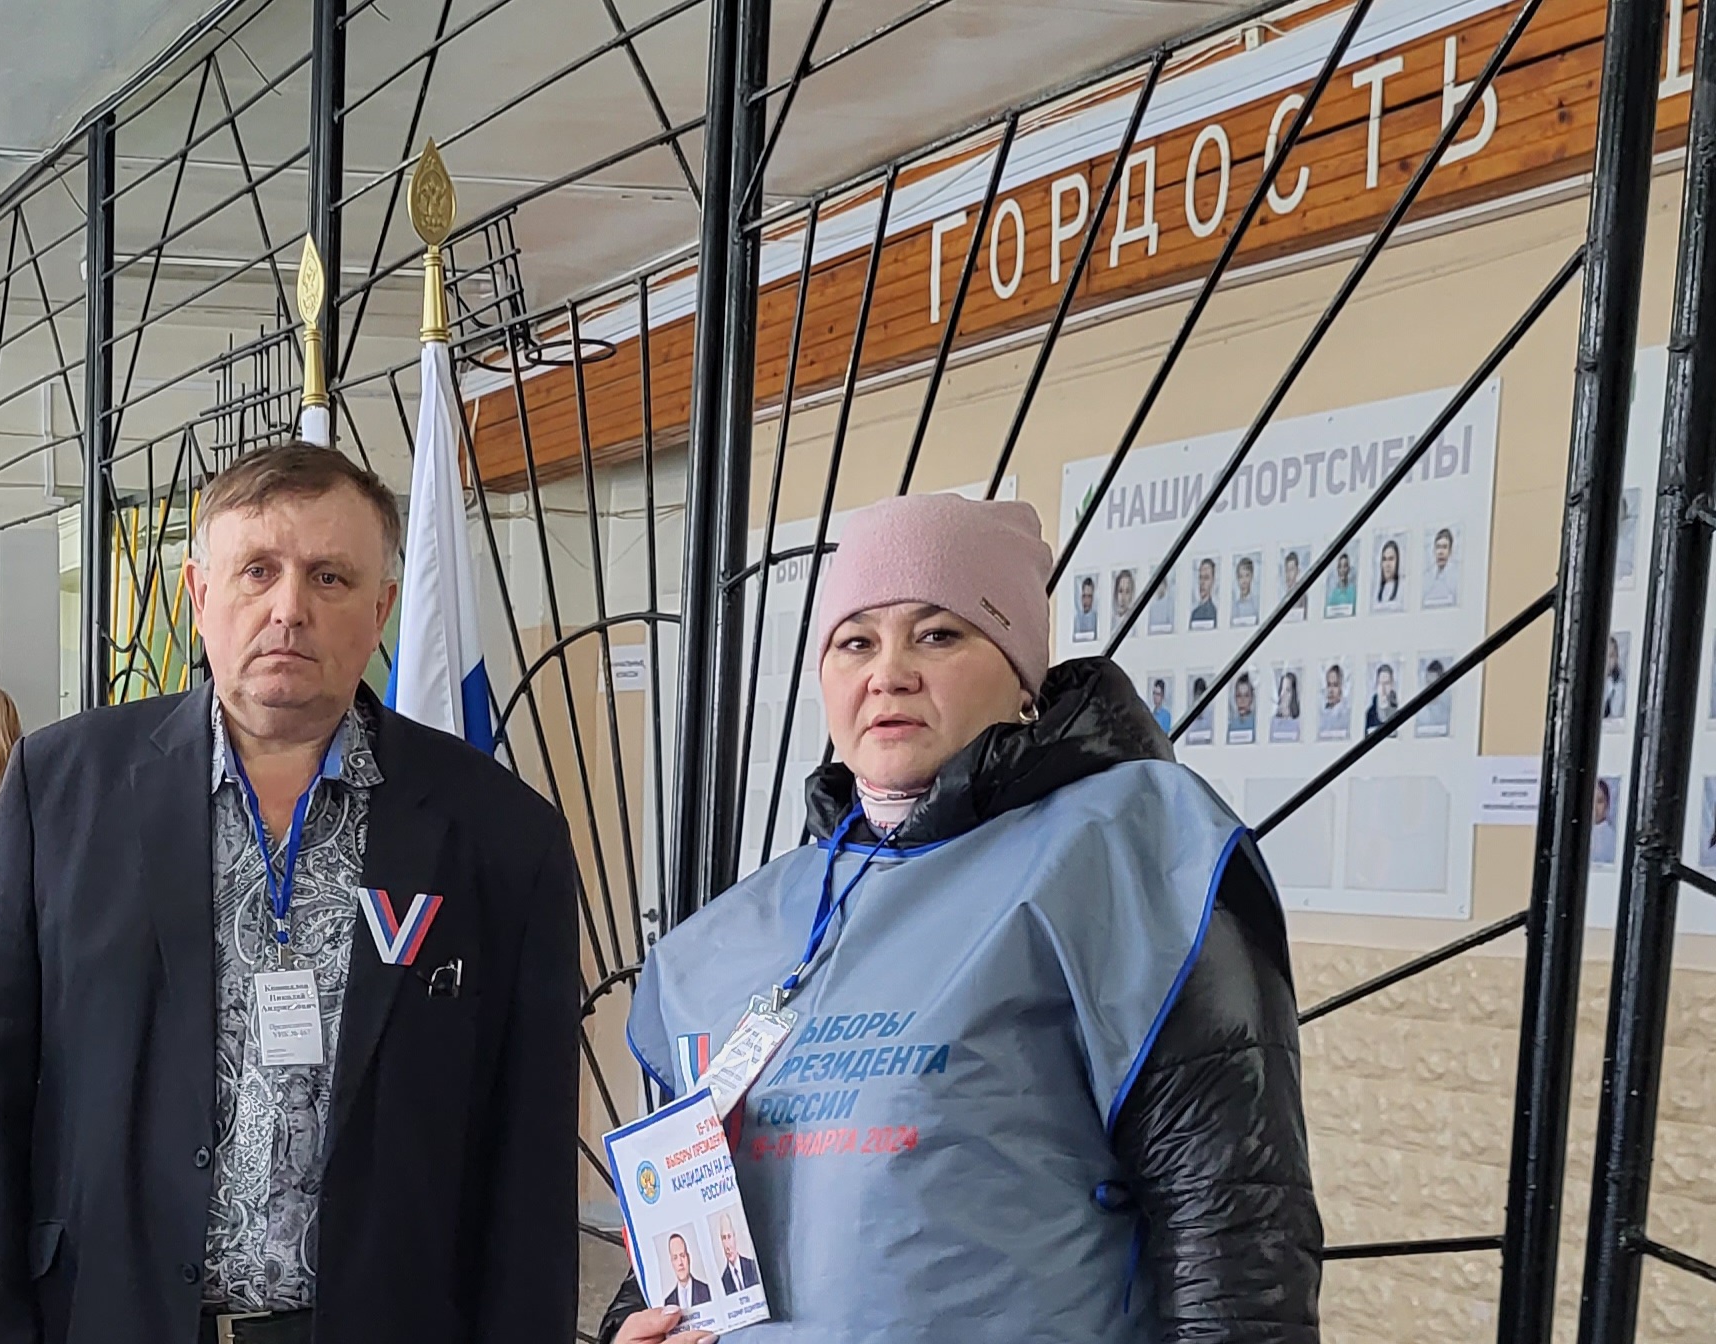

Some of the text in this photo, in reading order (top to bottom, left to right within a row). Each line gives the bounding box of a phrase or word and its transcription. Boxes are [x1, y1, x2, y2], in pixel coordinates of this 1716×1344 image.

[928, 36, 1499, 324] ГОРДОСТЬ
[1106, 425, 1474, 530] НАШИ СПОРТСМЕНЫ
[792, 1010, 917, 1050] ЫБОРЫ
[756, 1088, 860, 1126] РОССИИ
[792, 1125, 857, 1158] МАРТА
[860, 1124, 920, 1153] 2024
[671, 1162, 715, 1192] КАНДИДАТЫ
